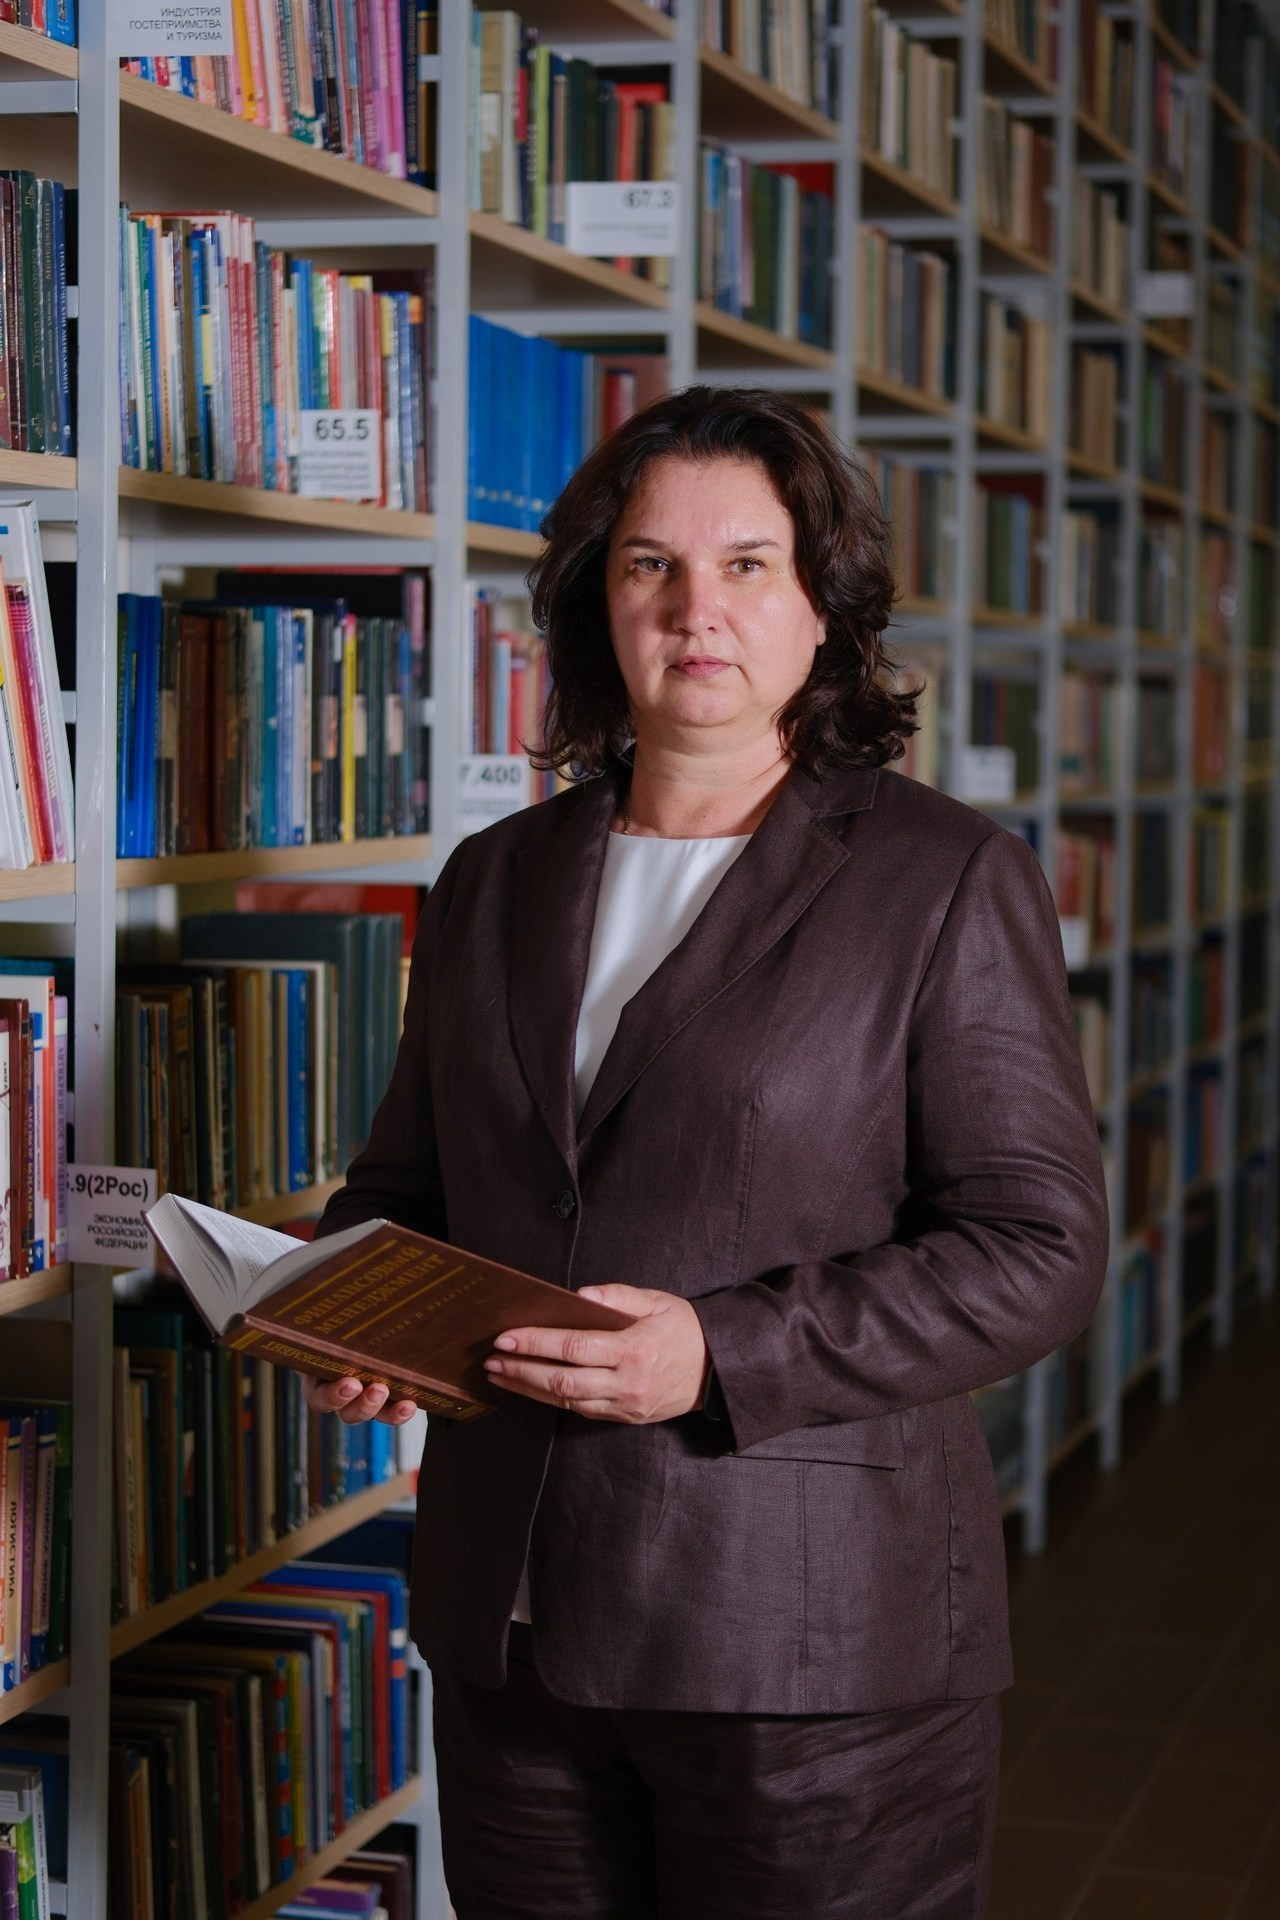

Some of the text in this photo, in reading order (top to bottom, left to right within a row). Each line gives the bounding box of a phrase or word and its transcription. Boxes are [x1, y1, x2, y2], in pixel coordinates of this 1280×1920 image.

[160, 7, 221, 17] ИНДУСТРИЯ
[129, 19, 222, 29] ГОСТЕПРИИМСТВА
[166, 31, 223, 40] И ТУРИЗМА
[626, 188, 673, 209] 67.3
[315, 418, 369, 440] 65.5
[94, 1213, 146, 1226] ЭКОНОМИК
[87, 1225, 148, 1239] РОССИЙСКОЙ
[95, 1238, 148, 1251] ФЕДЕРАЦИИ
[293, 1245, 426, 1326] ФИНАНСОВЫЙ
[313, 1254, 448, 1334] МЕНЕДЖМЕНТ
[8, 1500, 18, 1599] ЛОГИСТИКА
